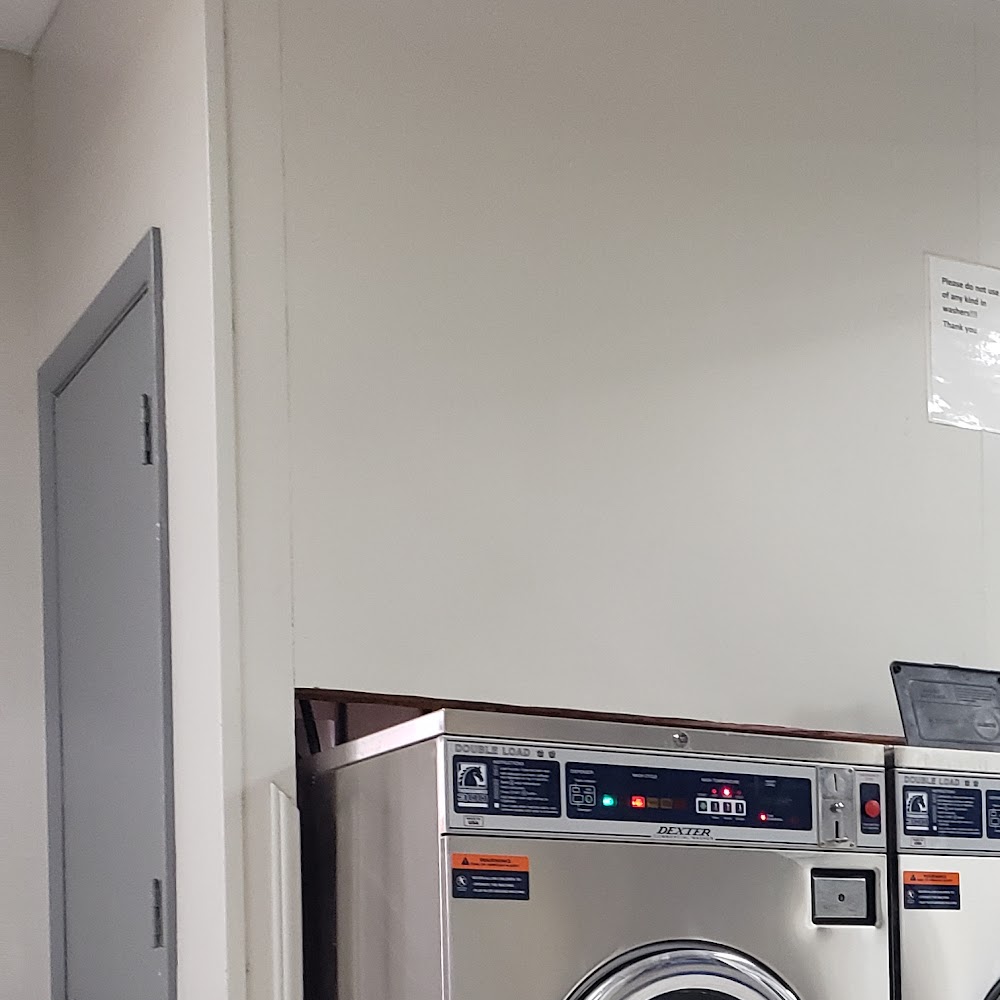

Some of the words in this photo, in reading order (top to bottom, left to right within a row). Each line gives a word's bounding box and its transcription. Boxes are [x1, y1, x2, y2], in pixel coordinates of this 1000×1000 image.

[942, 277, 963, 288] Please
[965, 282, 974, 290] do
[988, 288, 999, 296] use
[951, 294, 962, 303] any
[964, 296, 978, 305] kind
[943, 320, 963, 331] Thank
[455, 744, 498, 755] DOUBLE
[502, 747, 531, 757] LOAD
[904, 776, 936, 785] DOUBLE
[938, 778, 960, 786] LOAD
[657, 827, 711, 837] DEXTER
